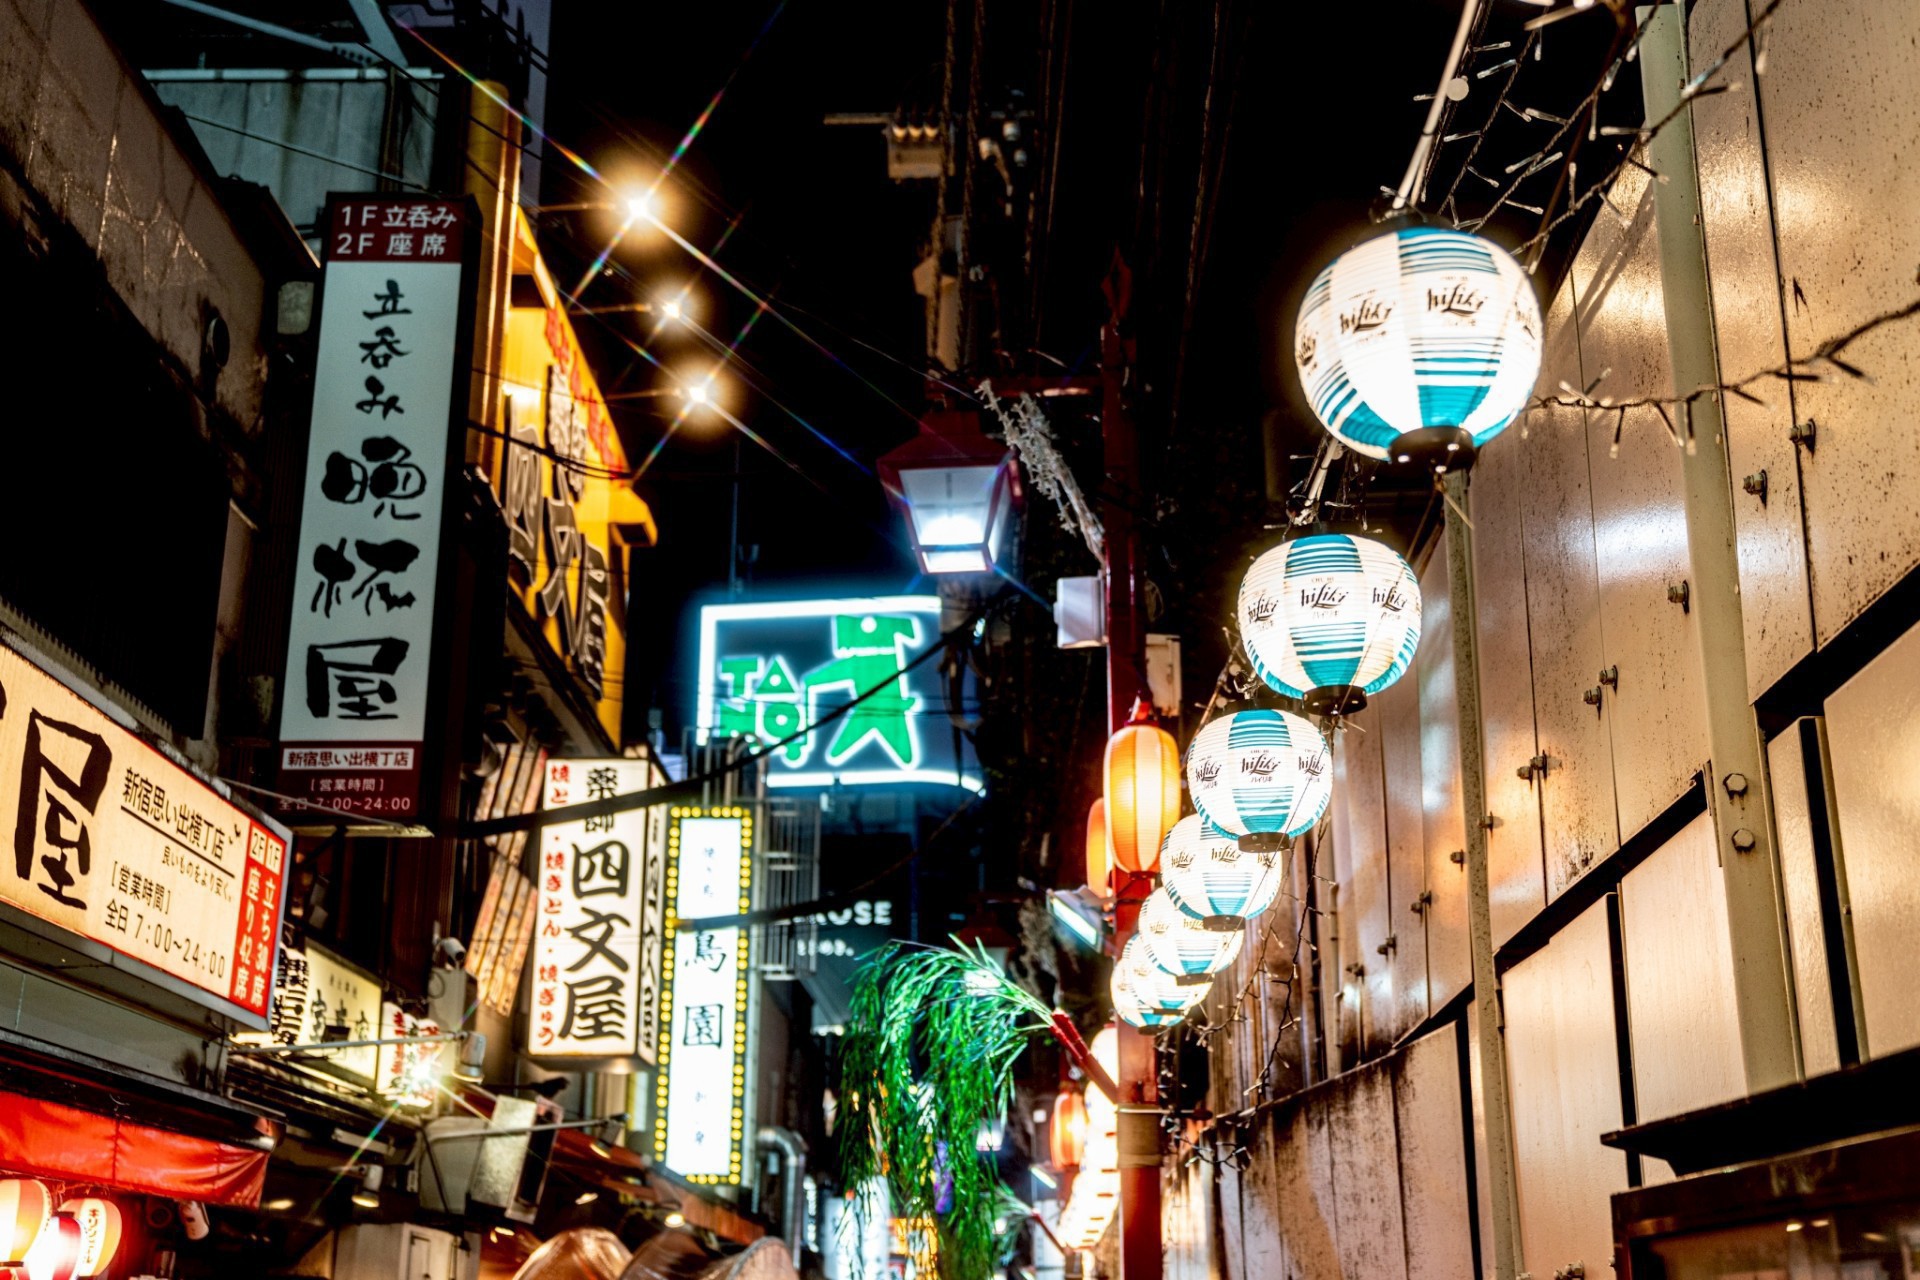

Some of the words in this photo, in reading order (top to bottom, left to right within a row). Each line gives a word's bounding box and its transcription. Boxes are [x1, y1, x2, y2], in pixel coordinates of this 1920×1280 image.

[342, 206, 378, 227] 1F
[383, 206, 457, 228] 立呑み
[336, 233, 376, 255] 2F
[288, 751, 409, 767] 新宿思い出横丁店
[0, 679, 112, 911] 屋
[121, 766, 225, 861] 新宿思い出横丁店
[253, 833, 265, 857] 2F
[269, 844, 281, 869] 1F
[105, 898, 130, 934] 全日
[558, 840, 631, 1041] 四文屋
[683, 931, 727, 1050] 鳥園
